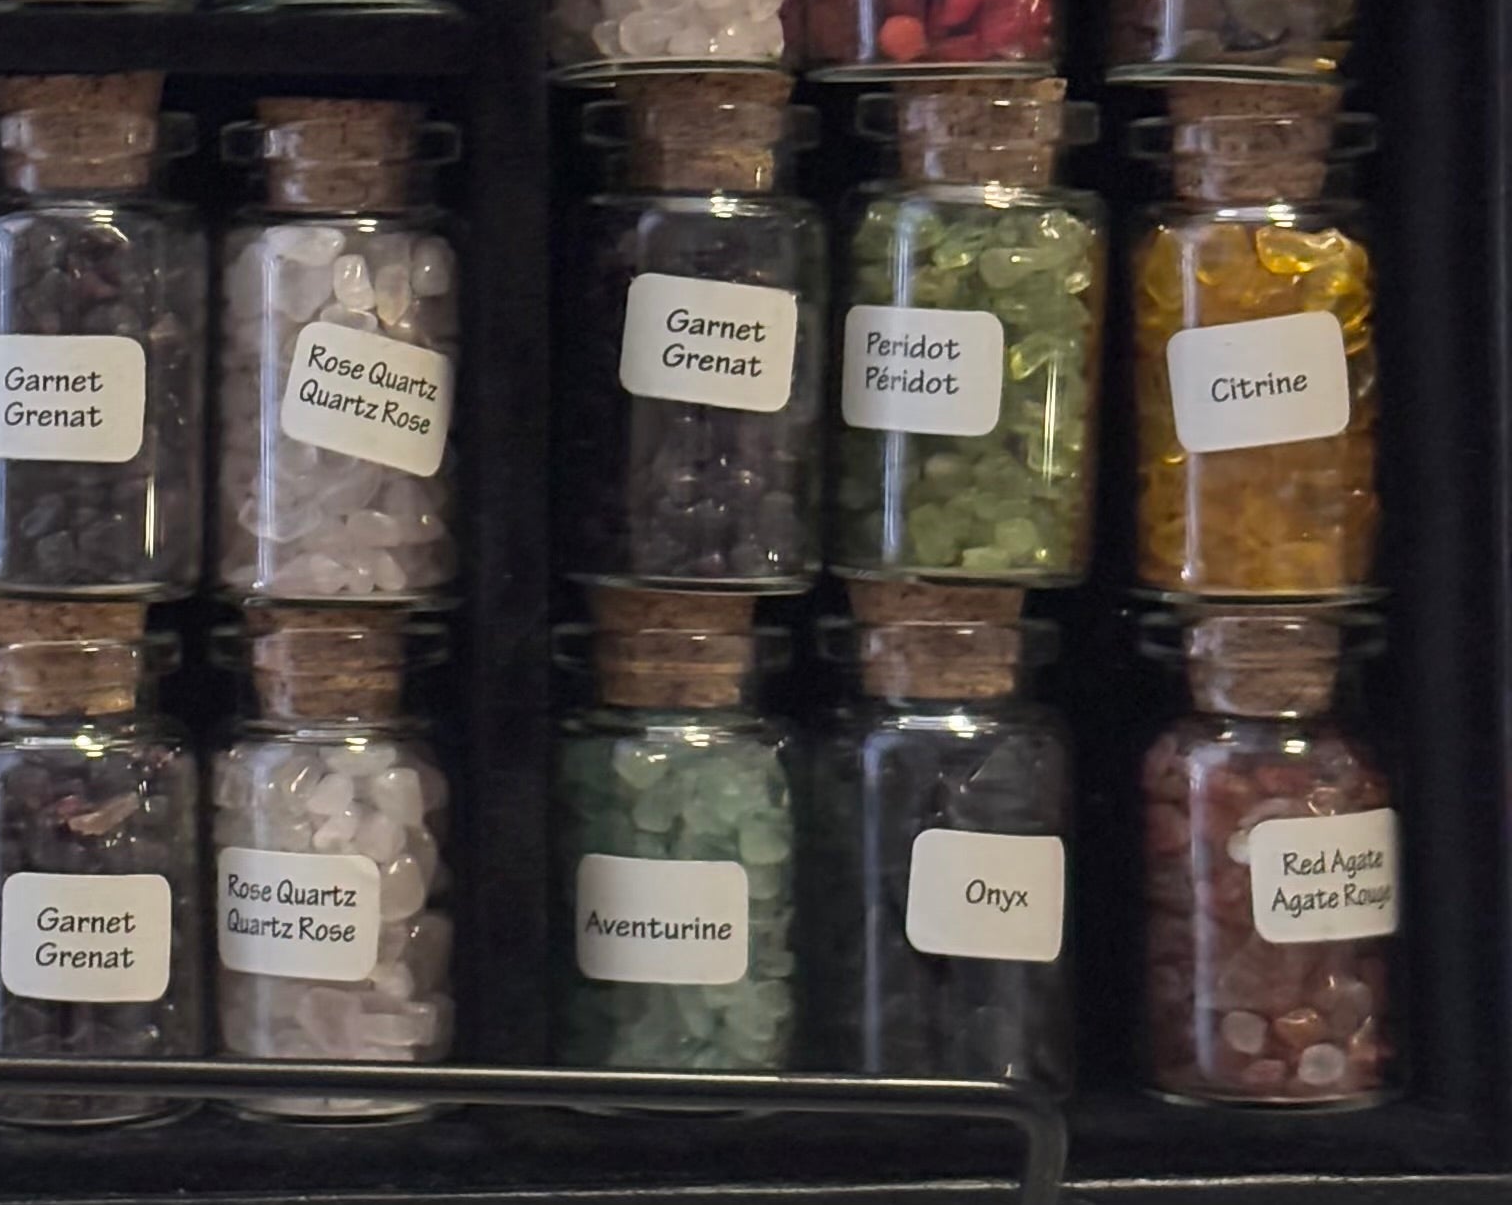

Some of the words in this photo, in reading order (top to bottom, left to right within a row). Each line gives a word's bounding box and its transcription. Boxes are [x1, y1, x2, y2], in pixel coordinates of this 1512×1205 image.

[665, 309, 767, 342] Garnet
[866, 331, 961, 360] Peridot
[307, 344, 366, 380] Rose
[368, 361, 438, 402] Quartz
[662, 344, 763, 379] Grenat
[4, 366, 103, 393] Garnet
[865, 366, 960, 395] Péridot
[1210, 372, 1309, 404] Citrine
[3, 402, 103, 428] Grenat
[299, 379, 380, 420] Quartz
[380, 399, 431, 435] Rose
[1282, 851, 1326, 875] Red
[1330, 850, 1384, 879] Agate
[227, 874, 273, 901] Rose
[276, 880, 358, 909] Quartz
[965, 880, 1029, 908] Onyx
[1271, 886, 1340, 919] Agate
[37, 907, 136, 932] Garnet
[227, 908, 294, 939] Quartz
[298, 917, 357, 943] Rose
[584, 911, 733, 940] Aventurine
[35, 942, 135, 968] Grenat
